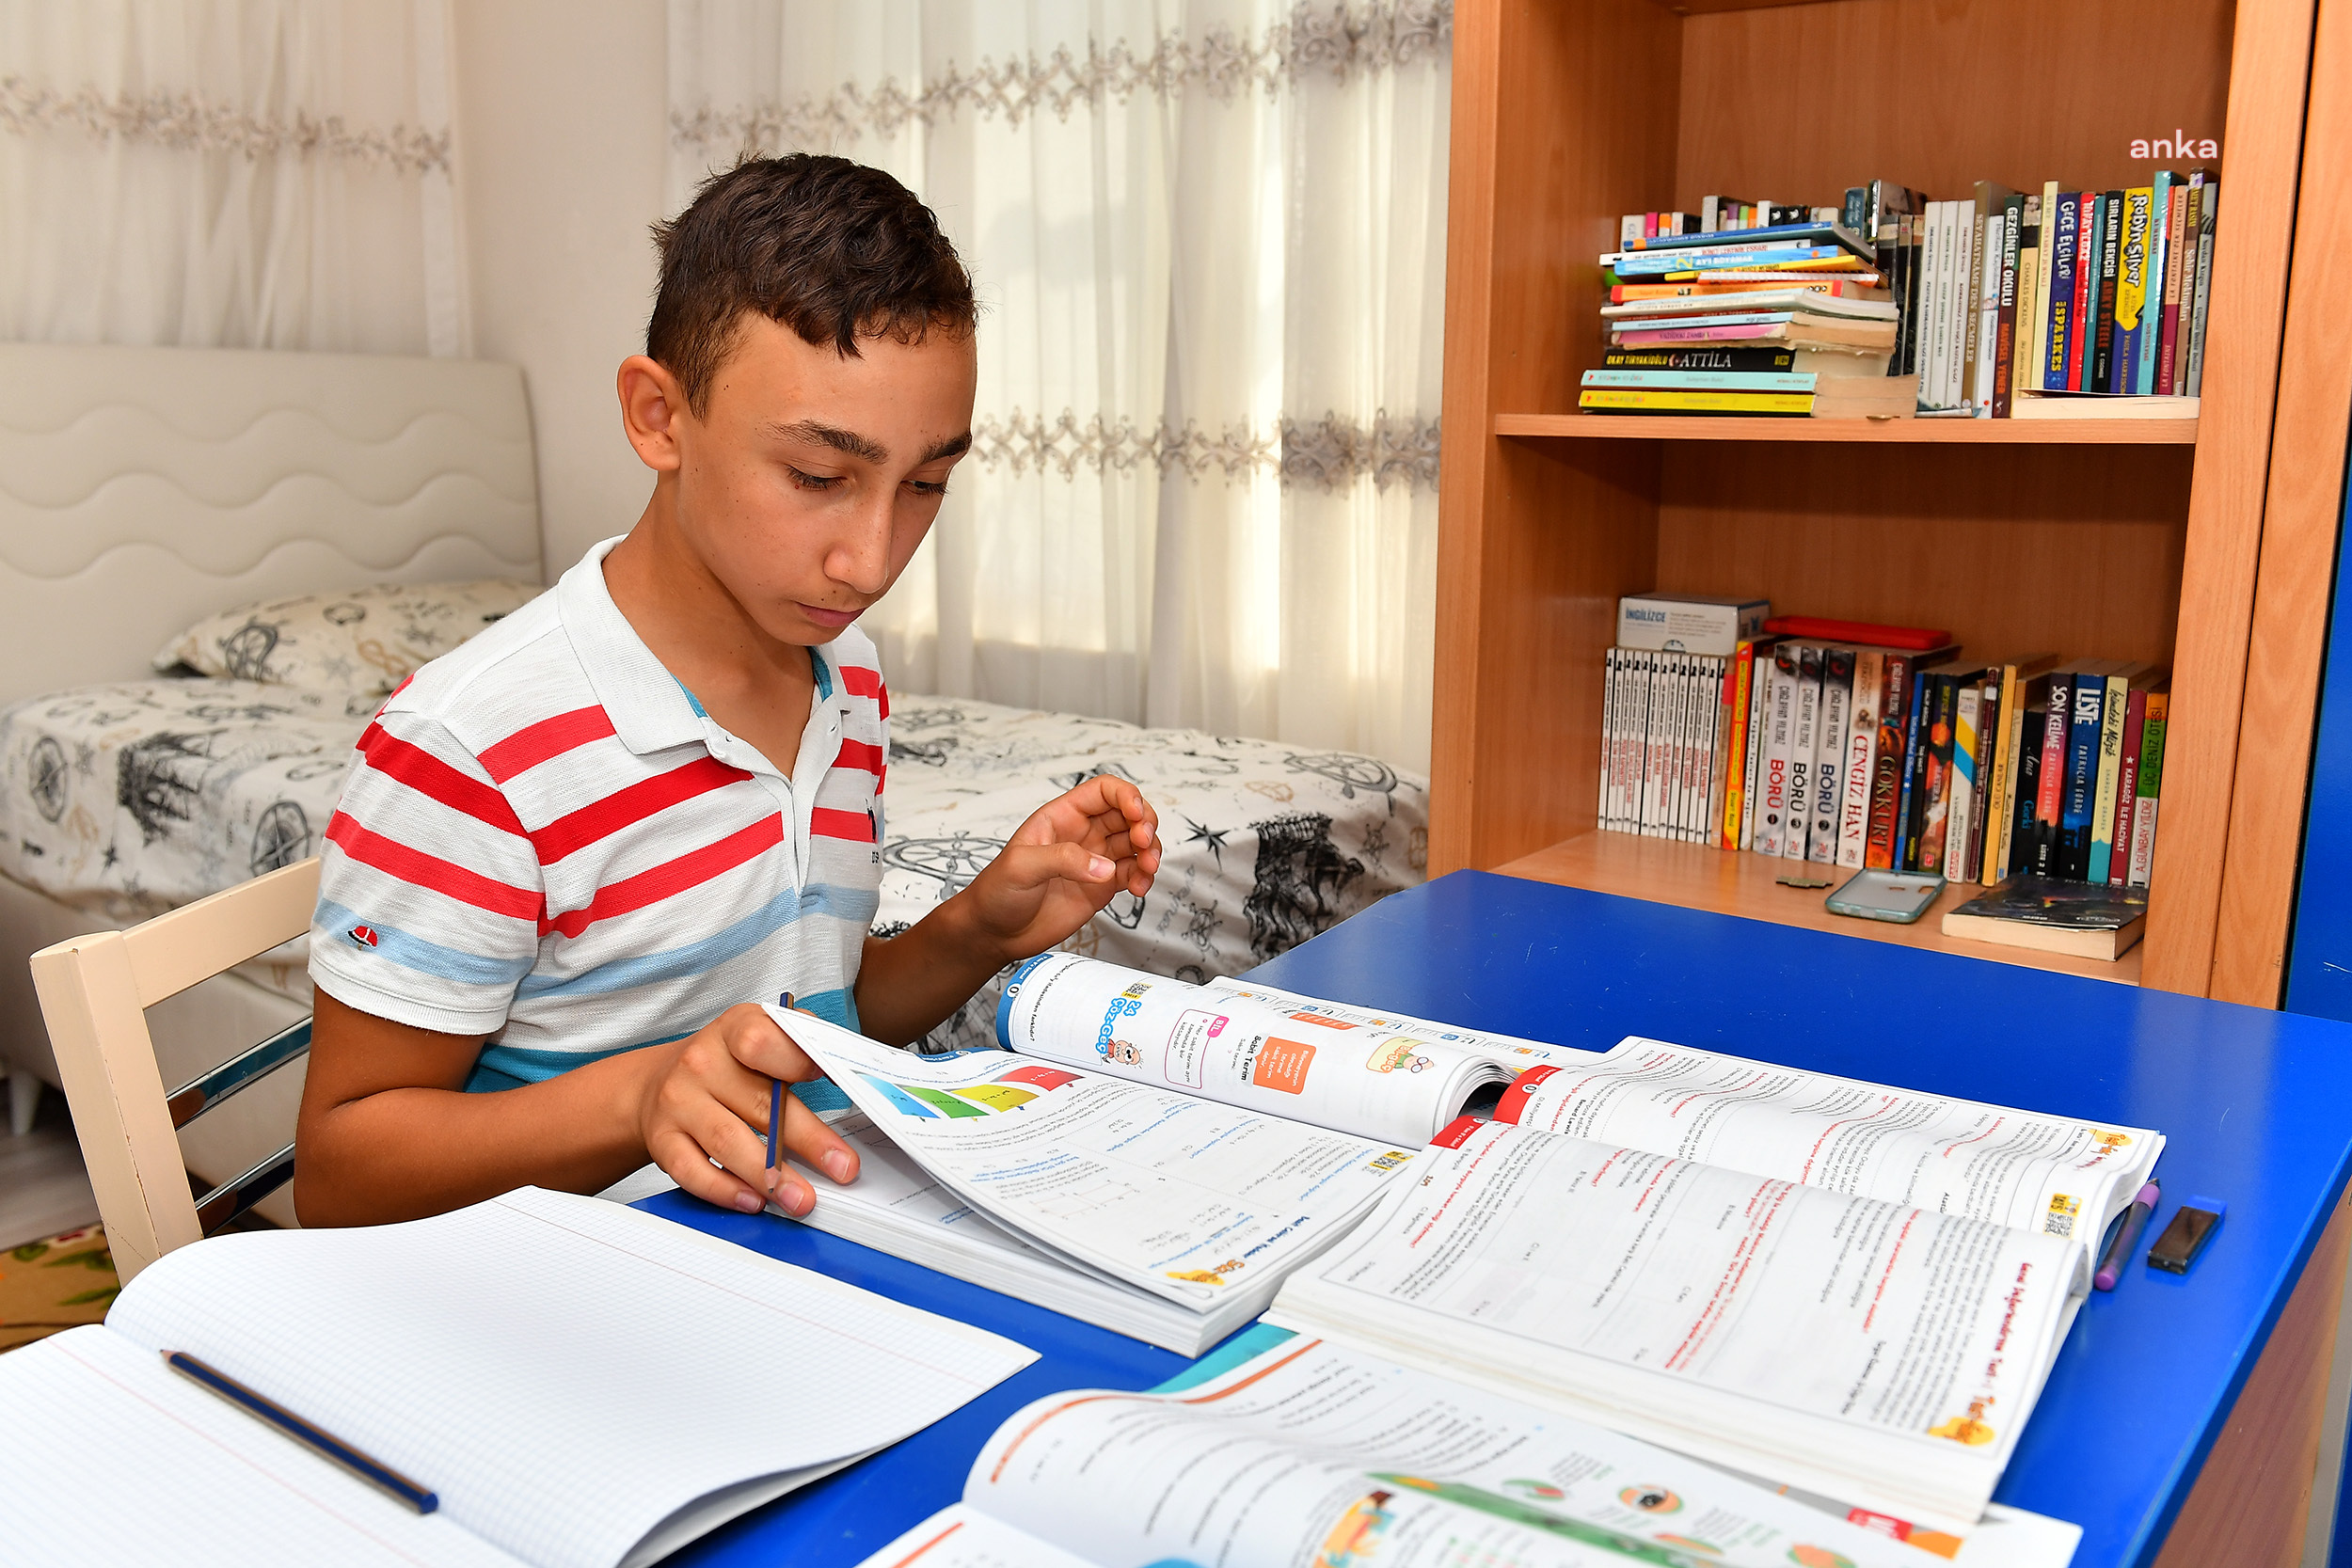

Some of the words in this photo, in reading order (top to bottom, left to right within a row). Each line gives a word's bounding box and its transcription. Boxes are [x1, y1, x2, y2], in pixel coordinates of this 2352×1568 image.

[2106, 198, 2119, 241] SIRLARIN
[2126, 193, 2150, 245] Robyn
[2002, 206, 2018, 267] GEZGİNLER
[2103, 241, 2116, 278] BEKÇİSİ
[2124, 242, 2143, 287] Silver
[2001, 269, 2014, 307] OKULU
[2022, 262, 2030, 295] CHARLES
[2101, 280, 2111, 308] ARKY
[1965, 311, 1976, 362] SEÇMELER
[1998, 322, 2010, 362] MAVİSEL
[2050, 307, 2066, 372] SPARKES
[2097, 312, 2109, 348] STEELE
[2122, 334, 2131, 358] PAULA
[1607, 355, 1624, 365] OKAY
[1680, 353, 1732, 368] ATTİLA
[1995, 364, 2007, 394] YENER
[1626, 607, 1665, 623] İNGİLİZCE
[2050, 685, 2067, 712] SON
[2075, 688, 2101, 725] LİSTE
[2106, 689, 2124, 726] İçimdeki
[2045, 714, 2064, 750] KELİME
[2148, 706, 2163, 736] ÖTESİ
[2101, 728, 2119, 756] Müzik
[2144, 738, 2159, 768] DENİZ
[1848, 734, 1871, 798] CENGİZ
[2075, 744, 2089, 784] PATRICIA
[2141, 771, 2156, 785] ÜÇ
[1768, 759, 1784, 809] BÖRÜ
[1791, 762, 1806, 812] BÖRÜ
[1818, 764, 1835, 813] BÖRÜ
[2122, 767, 2134, 804] KARAGÖZ
[1844, 802, 1863, 840] HAN
[2020, 800, 2034, 829] Gorki
[2121, 806, 2130, 818] İLE
[2116, 819, 2128, 853] HACİVAT
[1123, 1001, 1142, 1017] 24
[1095, 998, 1127, 1054] Çöz-Geç
[1248, 1036, 1262, 1054] Sabit
[1241, 1056, 1253, 1081] Terim
[1266, 1061, 1276, 1079] terim
[1277, 1053, 1288, 1074] terime
[1525, 1083, 1537, 1092] 0
[1550, 1094, 1572, 1132] aşağıdakilerden
[1572, 1100, 1586, 1117] Bernard
[1582, 1112, 1597, 1138] dayanarak
[1565, 1117, 1575, 1134] Lewis
